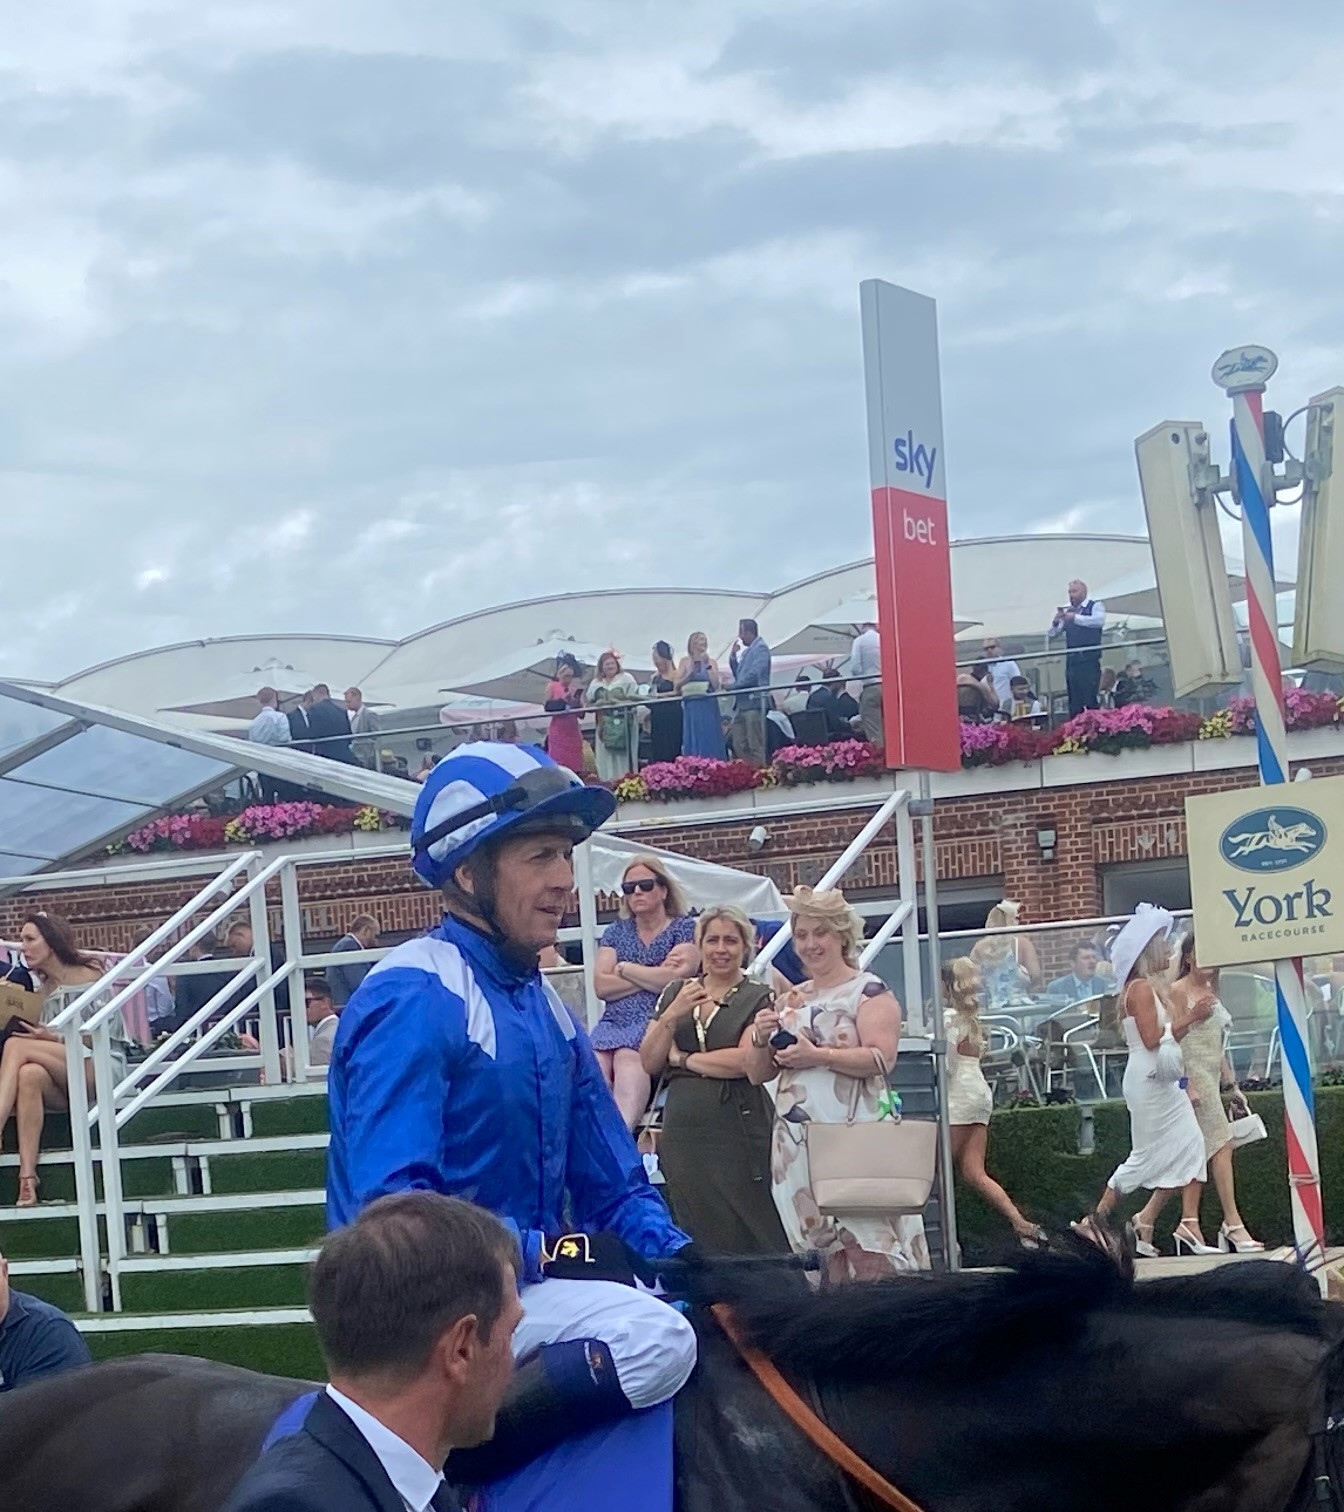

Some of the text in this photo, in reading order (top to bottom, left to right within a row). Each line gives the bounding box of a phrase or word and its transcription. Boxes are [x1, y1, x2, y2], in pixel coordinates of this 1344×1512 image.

[894, 429, 937, 489] sky
[902, 508, 937, 545] bet
[1222, 879, 1333, 928] York
[1241, 925, 1326, 942] RACECOURSE
